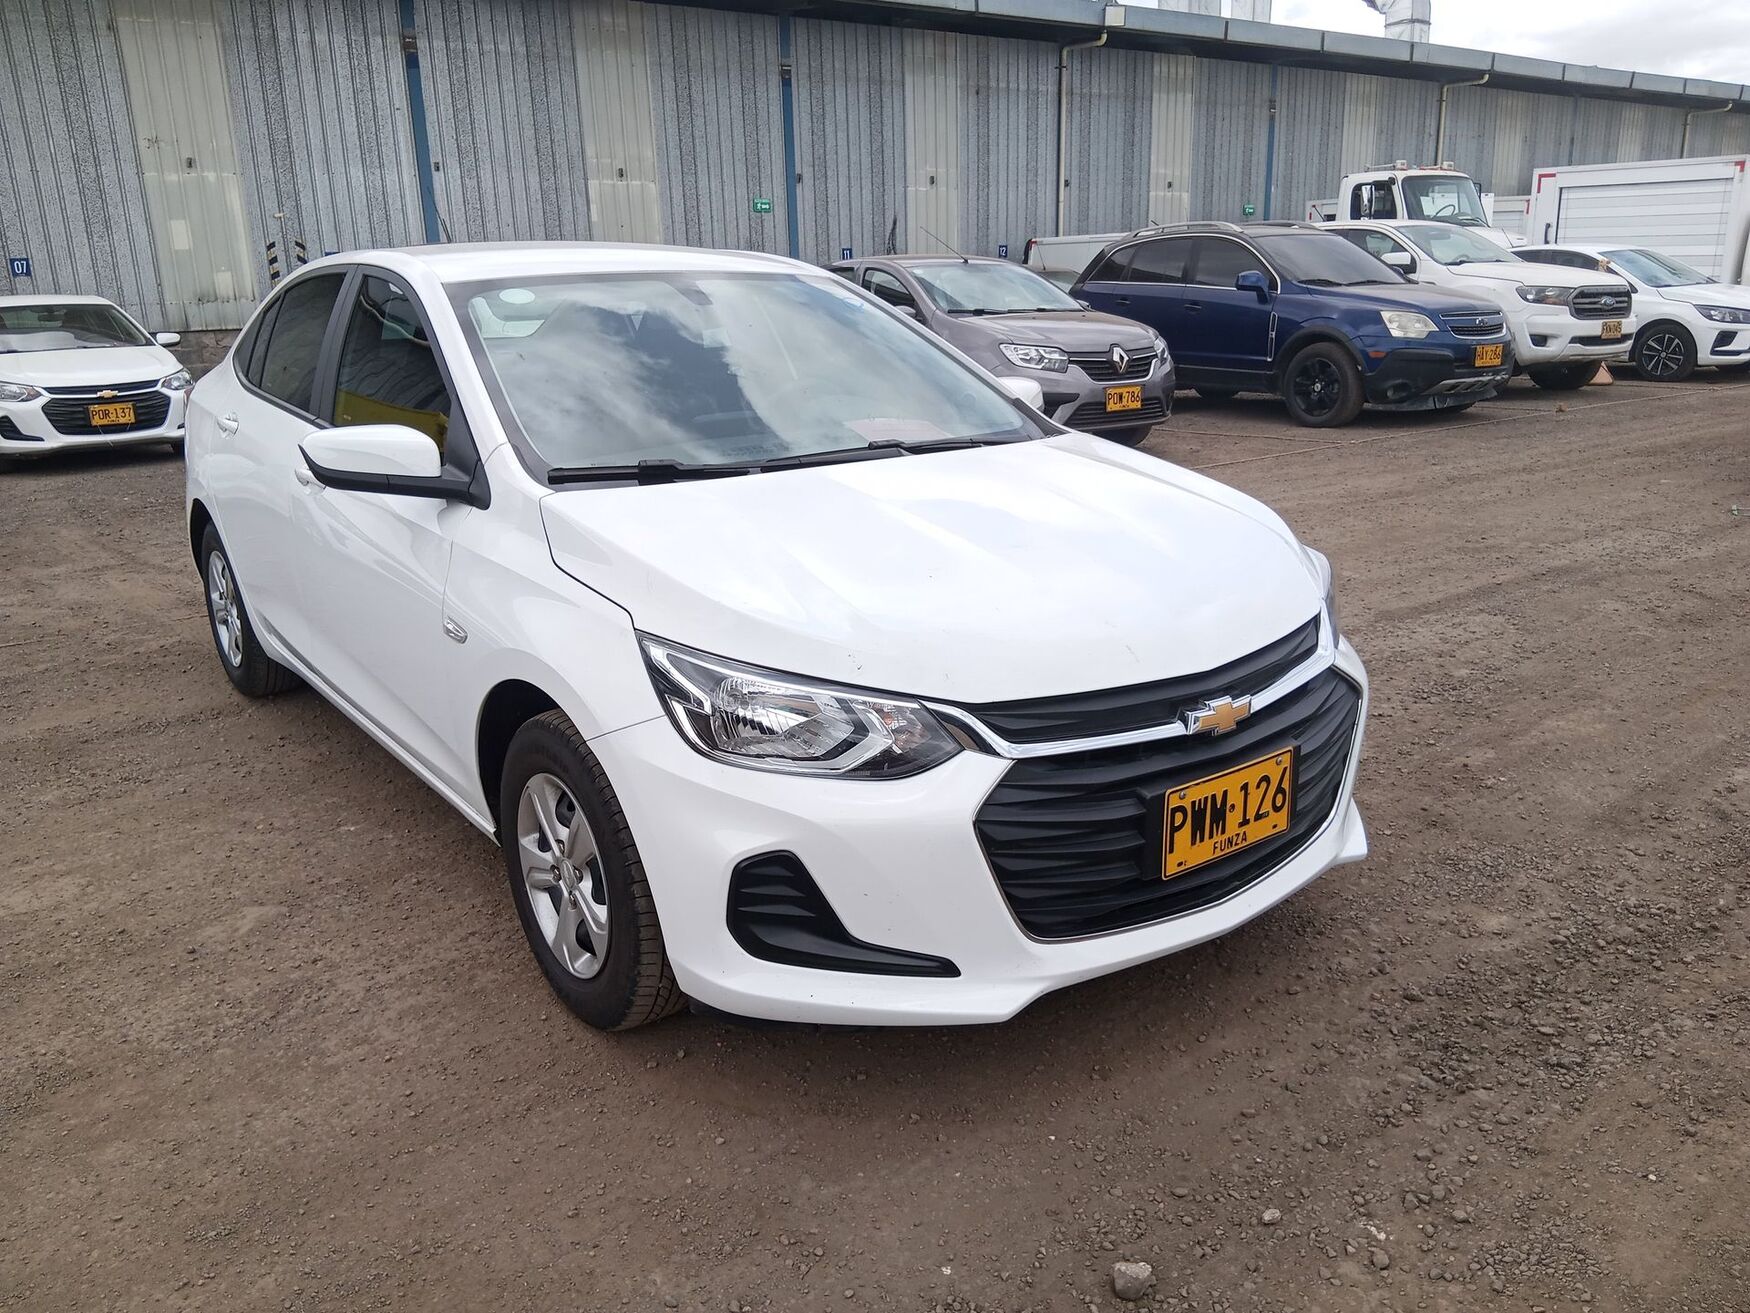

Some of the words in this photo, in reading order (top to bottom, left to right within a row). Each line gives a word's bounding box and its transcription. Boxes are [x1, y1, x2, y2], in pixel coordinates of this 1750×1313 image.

[843, 250, 850, 260] 11
[14, 260, 27, 274] 07
[1212, 830, 1248, 855] FUNZA
